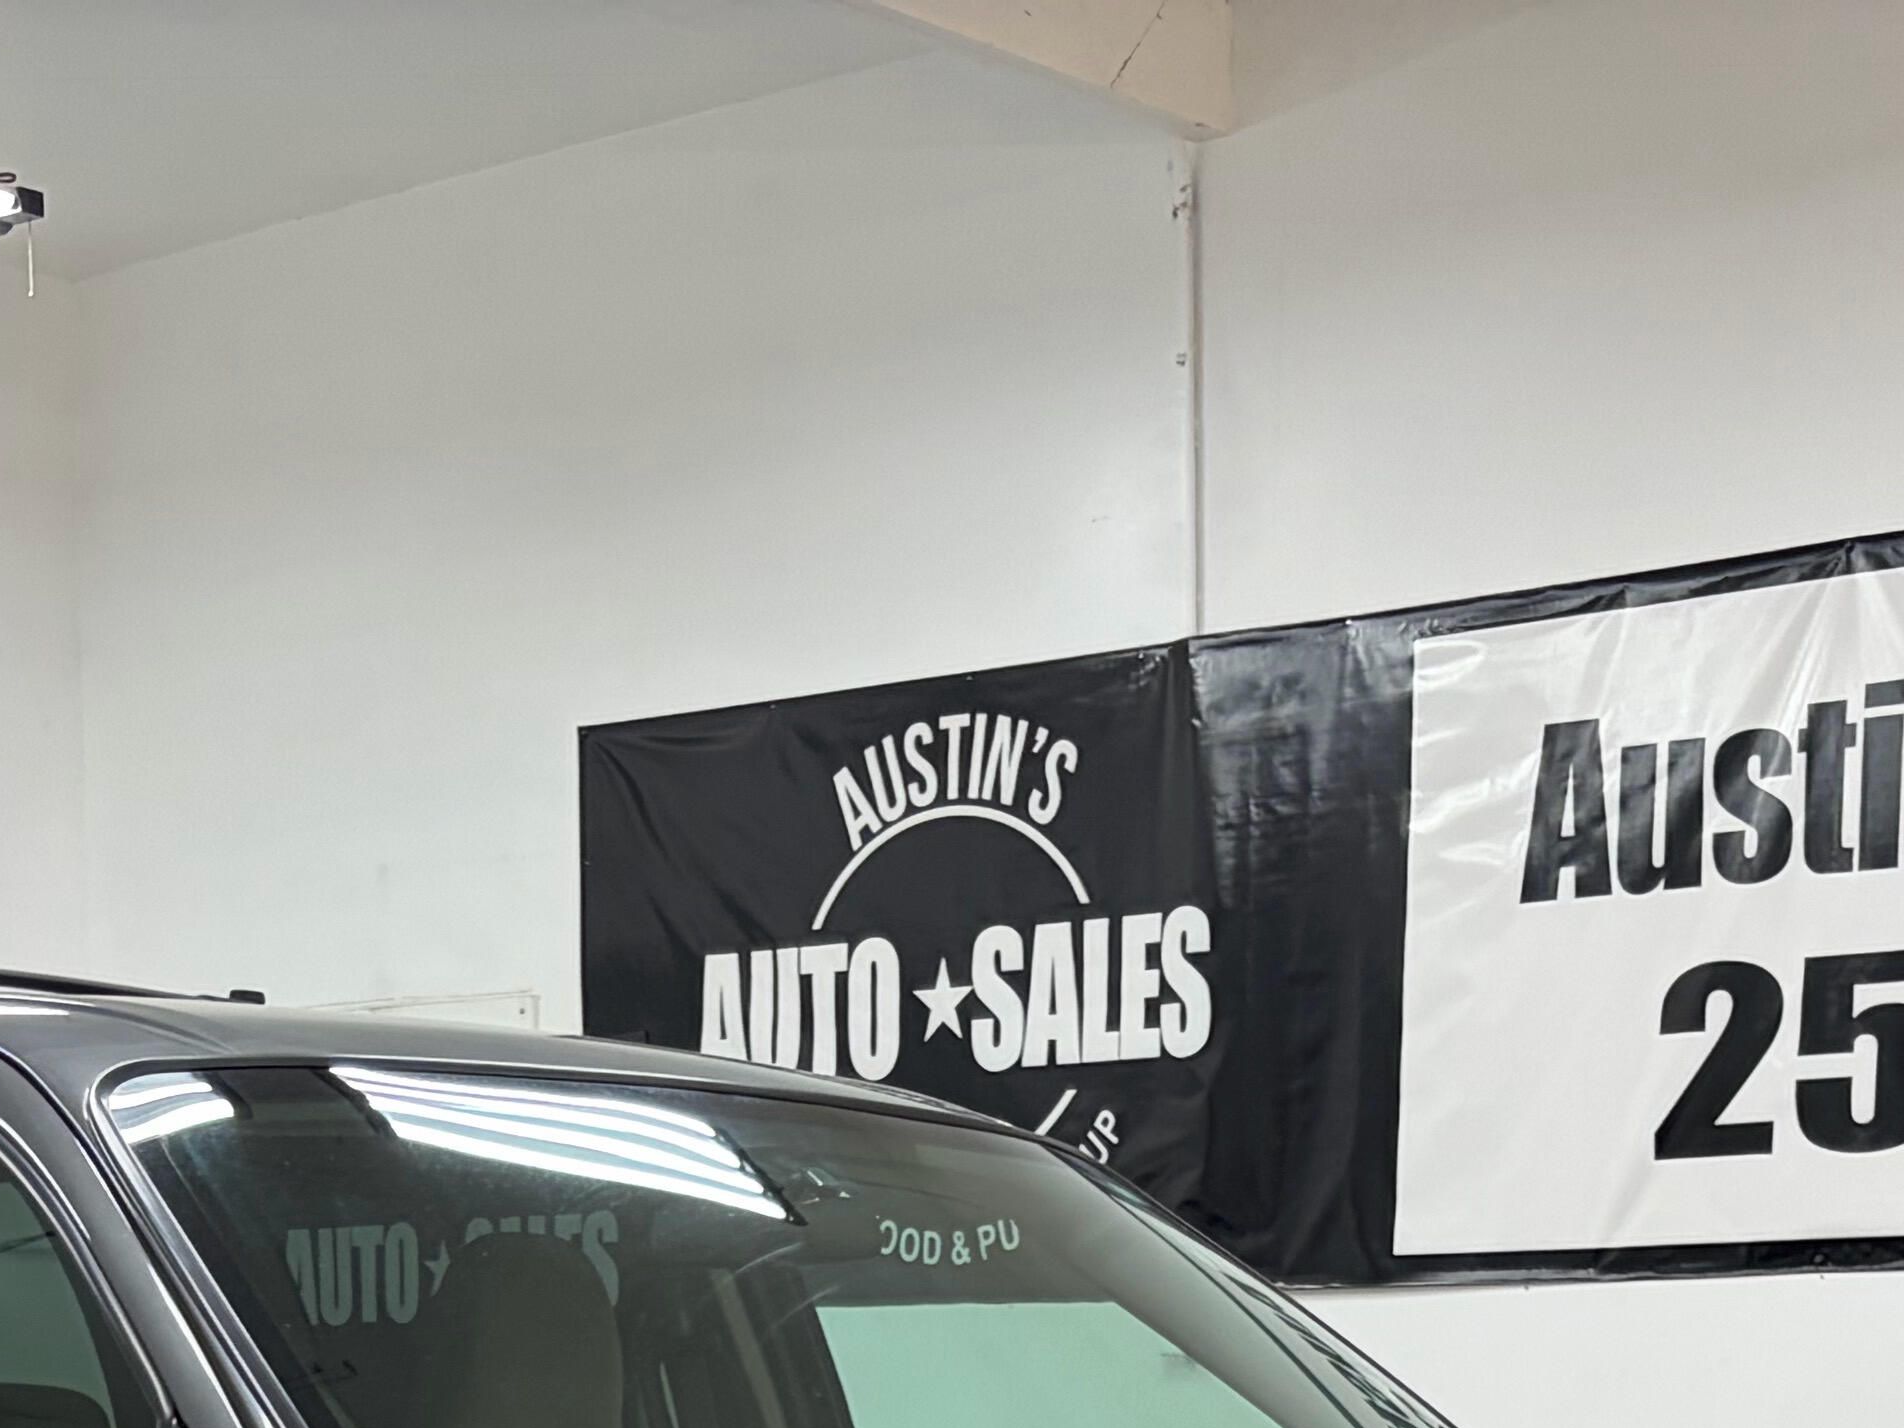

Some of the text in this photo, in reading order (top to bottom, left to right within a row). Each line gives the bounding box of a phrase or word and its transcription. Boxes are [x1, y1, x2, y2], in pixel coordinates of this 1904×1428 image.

[832, 712, 1078, 852] AUSTIN'S
[700, 905, 1212, 1081] AUTO SALES
